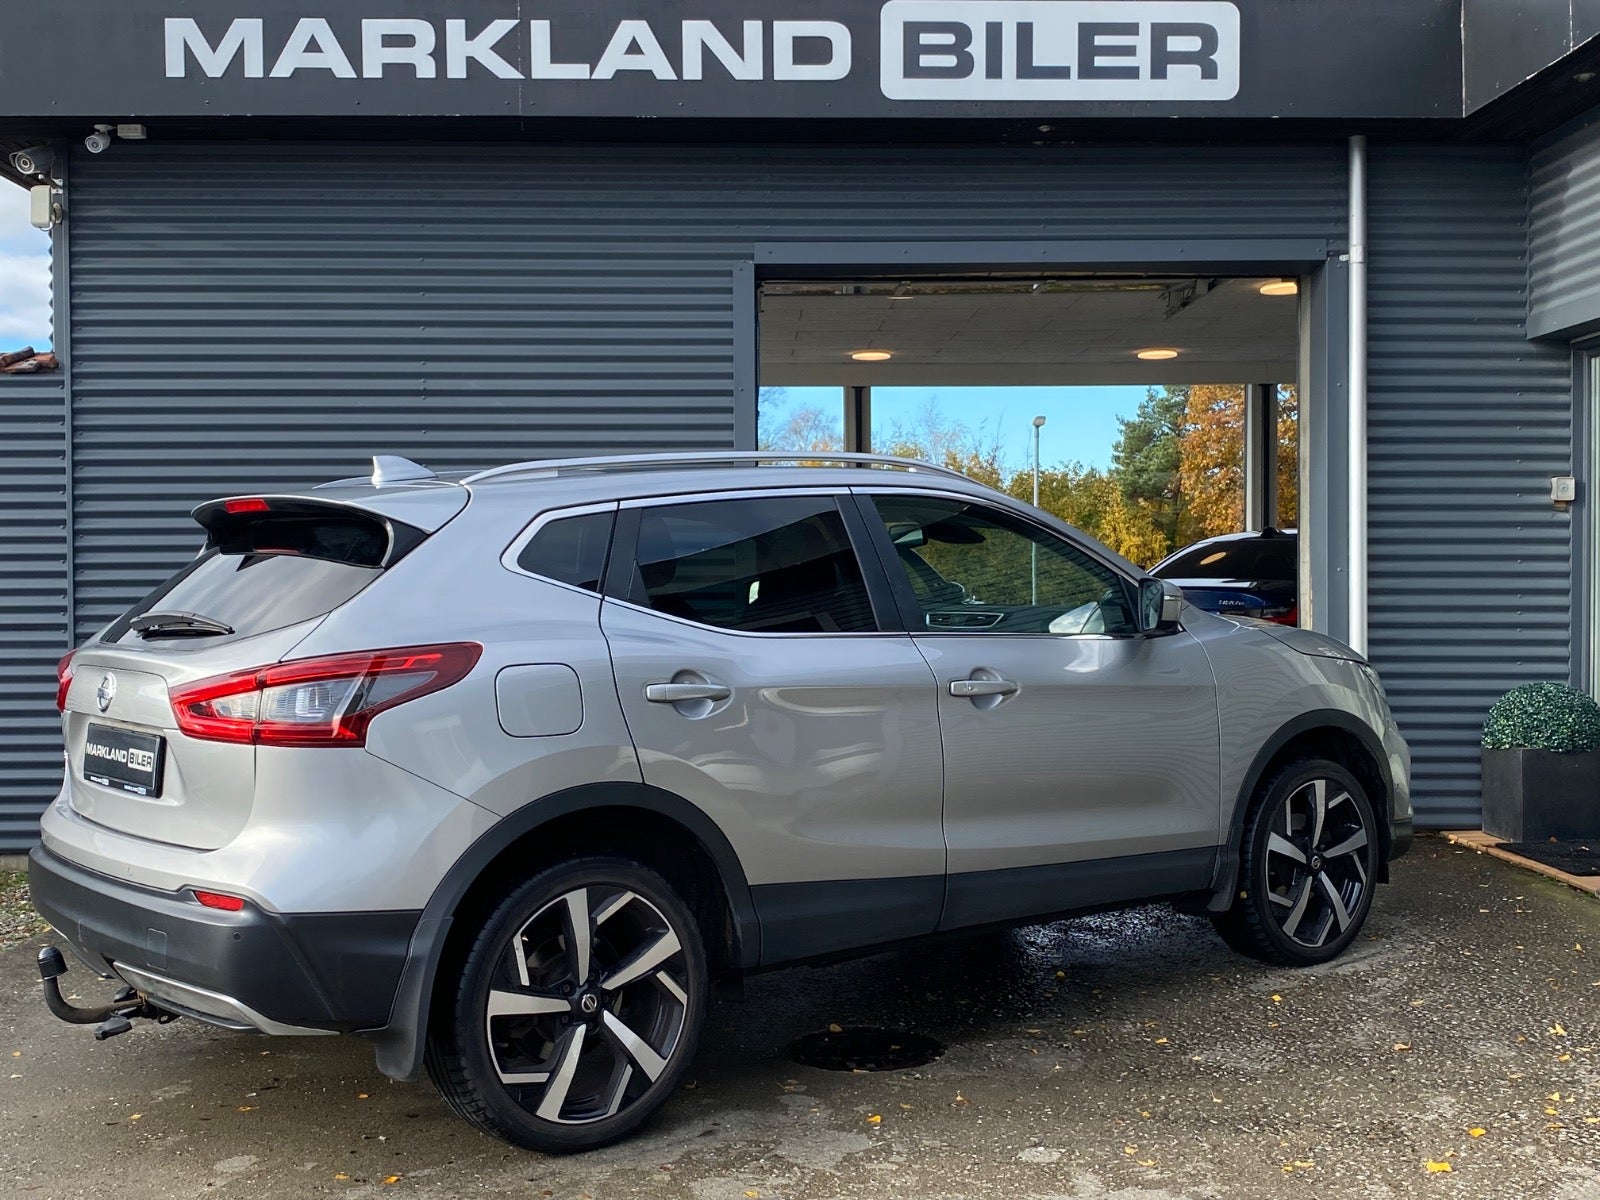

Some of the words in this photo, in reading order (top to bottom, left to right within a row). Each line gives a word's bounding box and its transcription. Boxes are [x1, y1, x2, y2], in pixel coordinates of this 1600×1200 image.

[164, 17, 852, 81] MARKLAND
[902, 20, 1219, 81] BILER
[86, 742, 127, 763] MARKLAND
[129, 751, 152, 768] BILER
